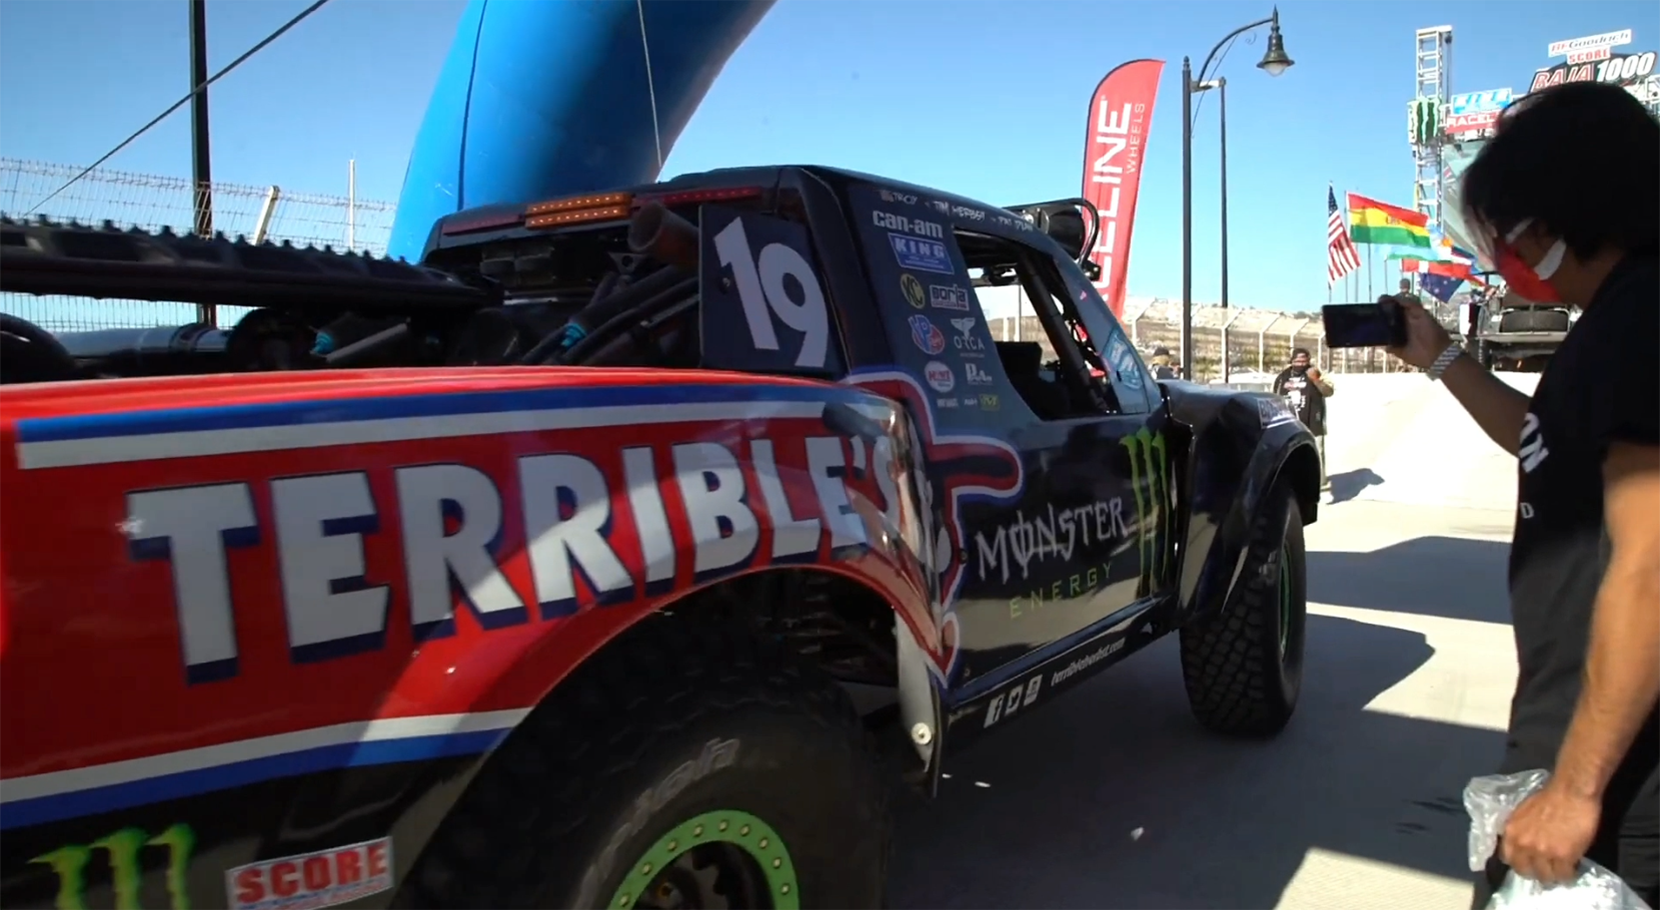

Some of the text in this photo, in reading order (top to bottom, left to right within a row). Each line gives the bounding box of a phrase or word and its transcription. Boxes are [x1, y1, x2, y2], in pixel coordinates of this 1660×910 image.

[1568, 48, 1609, 63] SCORE
[1596, 51, 1656, 83] 1000
[1126, 103, 1145, 174] WHEELS
[872, 210, 944, 238] can-am
[894, 237, 945, 259] KING
[712, 215, 830, 368] 19
[953, 336, 985, 350] ORCA
[125, 433, 905, 682] TERRIBLE'S
[1009, 562, 1112, 620] ENERGY
[235, 841, 391, 904] SCORE
